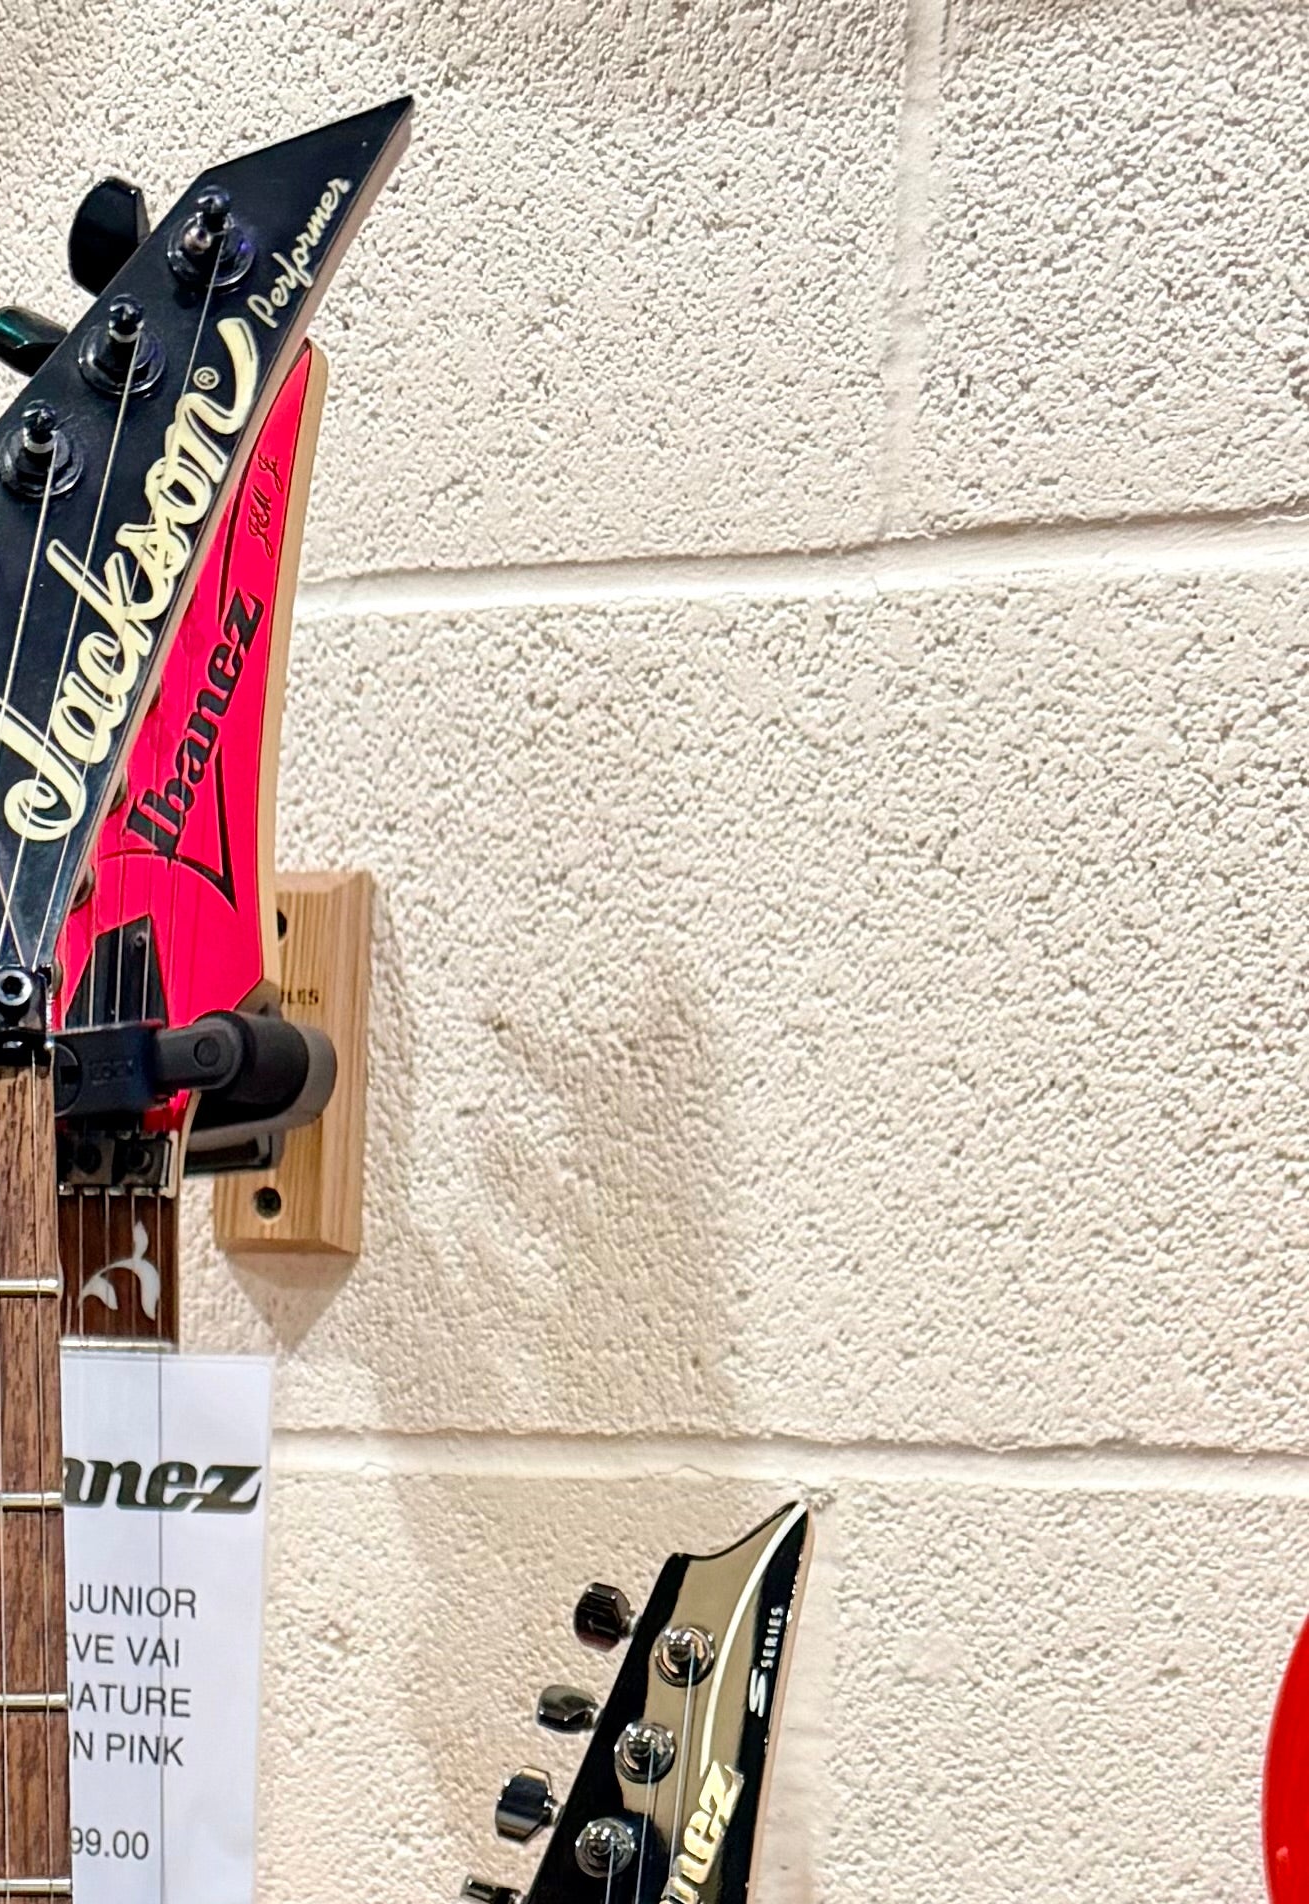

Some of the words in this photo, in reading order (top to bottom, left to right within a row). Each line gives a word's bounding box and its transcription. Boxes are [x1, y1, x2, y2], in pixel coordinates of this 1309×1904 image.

[247, 178, 353, 329] Performer
[127, 584, 264, 865] Ibanez
[69, 1583, 197, 1619] JUNIOR
[126, 1636, 180, 1668] VAI
[760, 1605, 784, 1669] SERIES
[106, 1732, 184, 1767] PINK
